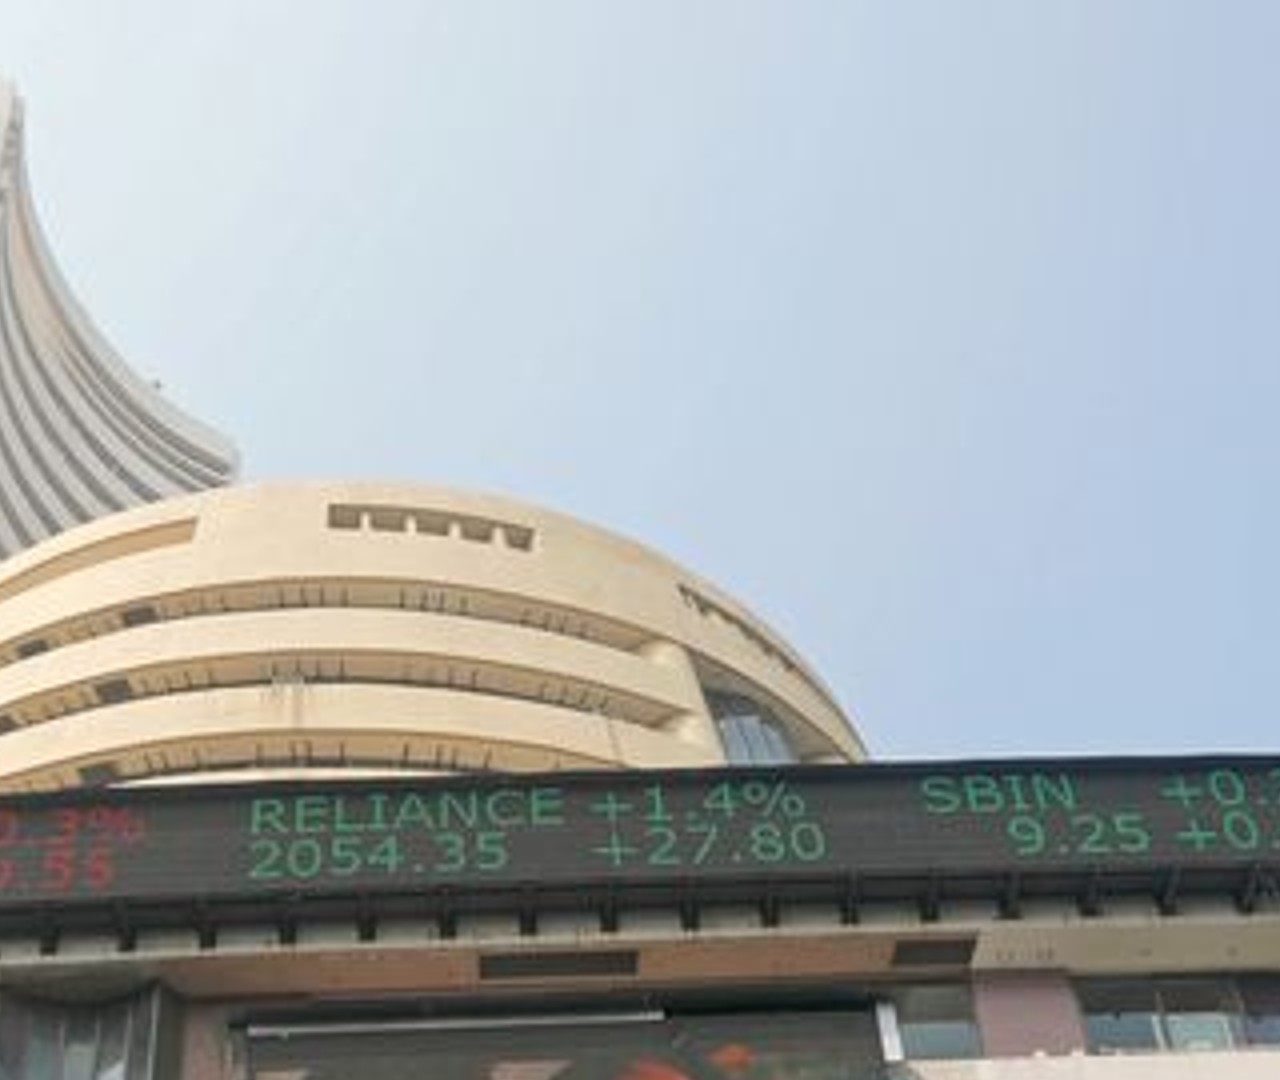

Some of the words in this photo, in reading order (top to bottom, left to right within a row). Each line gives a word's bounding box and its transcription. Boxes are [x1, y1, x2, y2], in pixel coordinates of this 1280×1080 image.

[249, 788, 564, 834] RELIANCE
[591, 782, 806, 824] +1.4%
[921, 774, 1077, 815] SBIN
[249, 830, 509, 879] 2054.35
[592, 821, 826, 867] +27.80
[1007, 814, 1151, 855] 9.25
